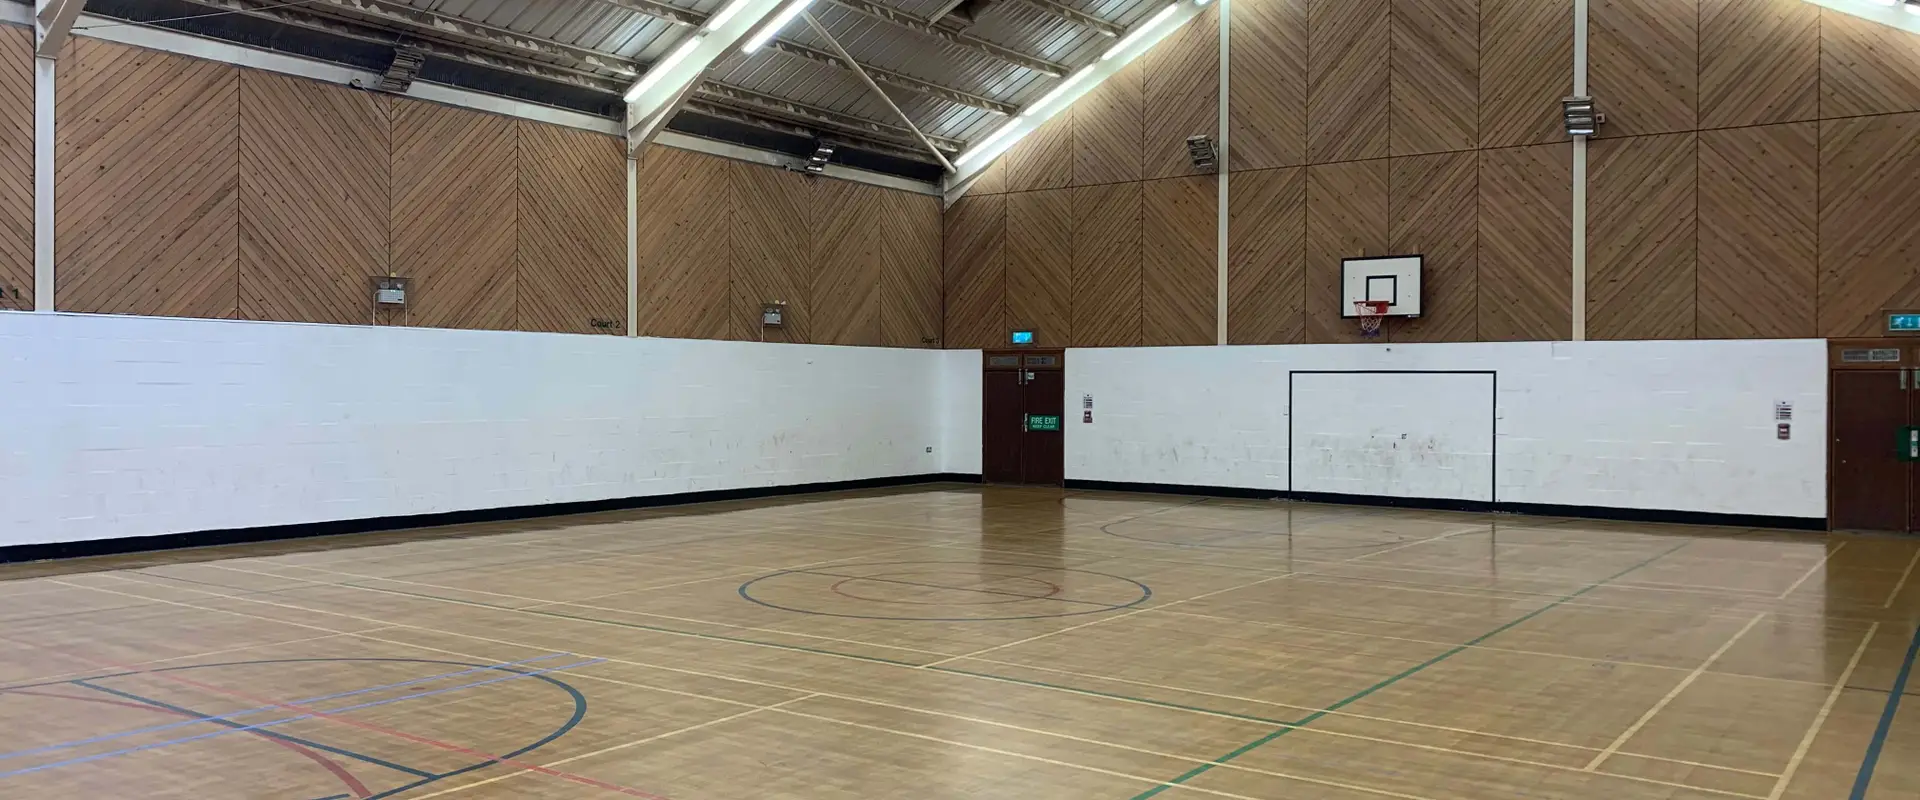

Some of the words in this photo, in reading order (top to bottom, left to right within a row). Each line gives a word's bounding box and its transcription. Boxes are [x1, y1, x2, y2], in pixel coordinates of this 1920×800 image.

[590, 318, 613, 328] Court
[615, 320, 621, 328] 2
[921, 336, 935, 344] Court
[1031, 416, 1043, 424] FIRE
[1044, 417, 1056, 425] EXIT
